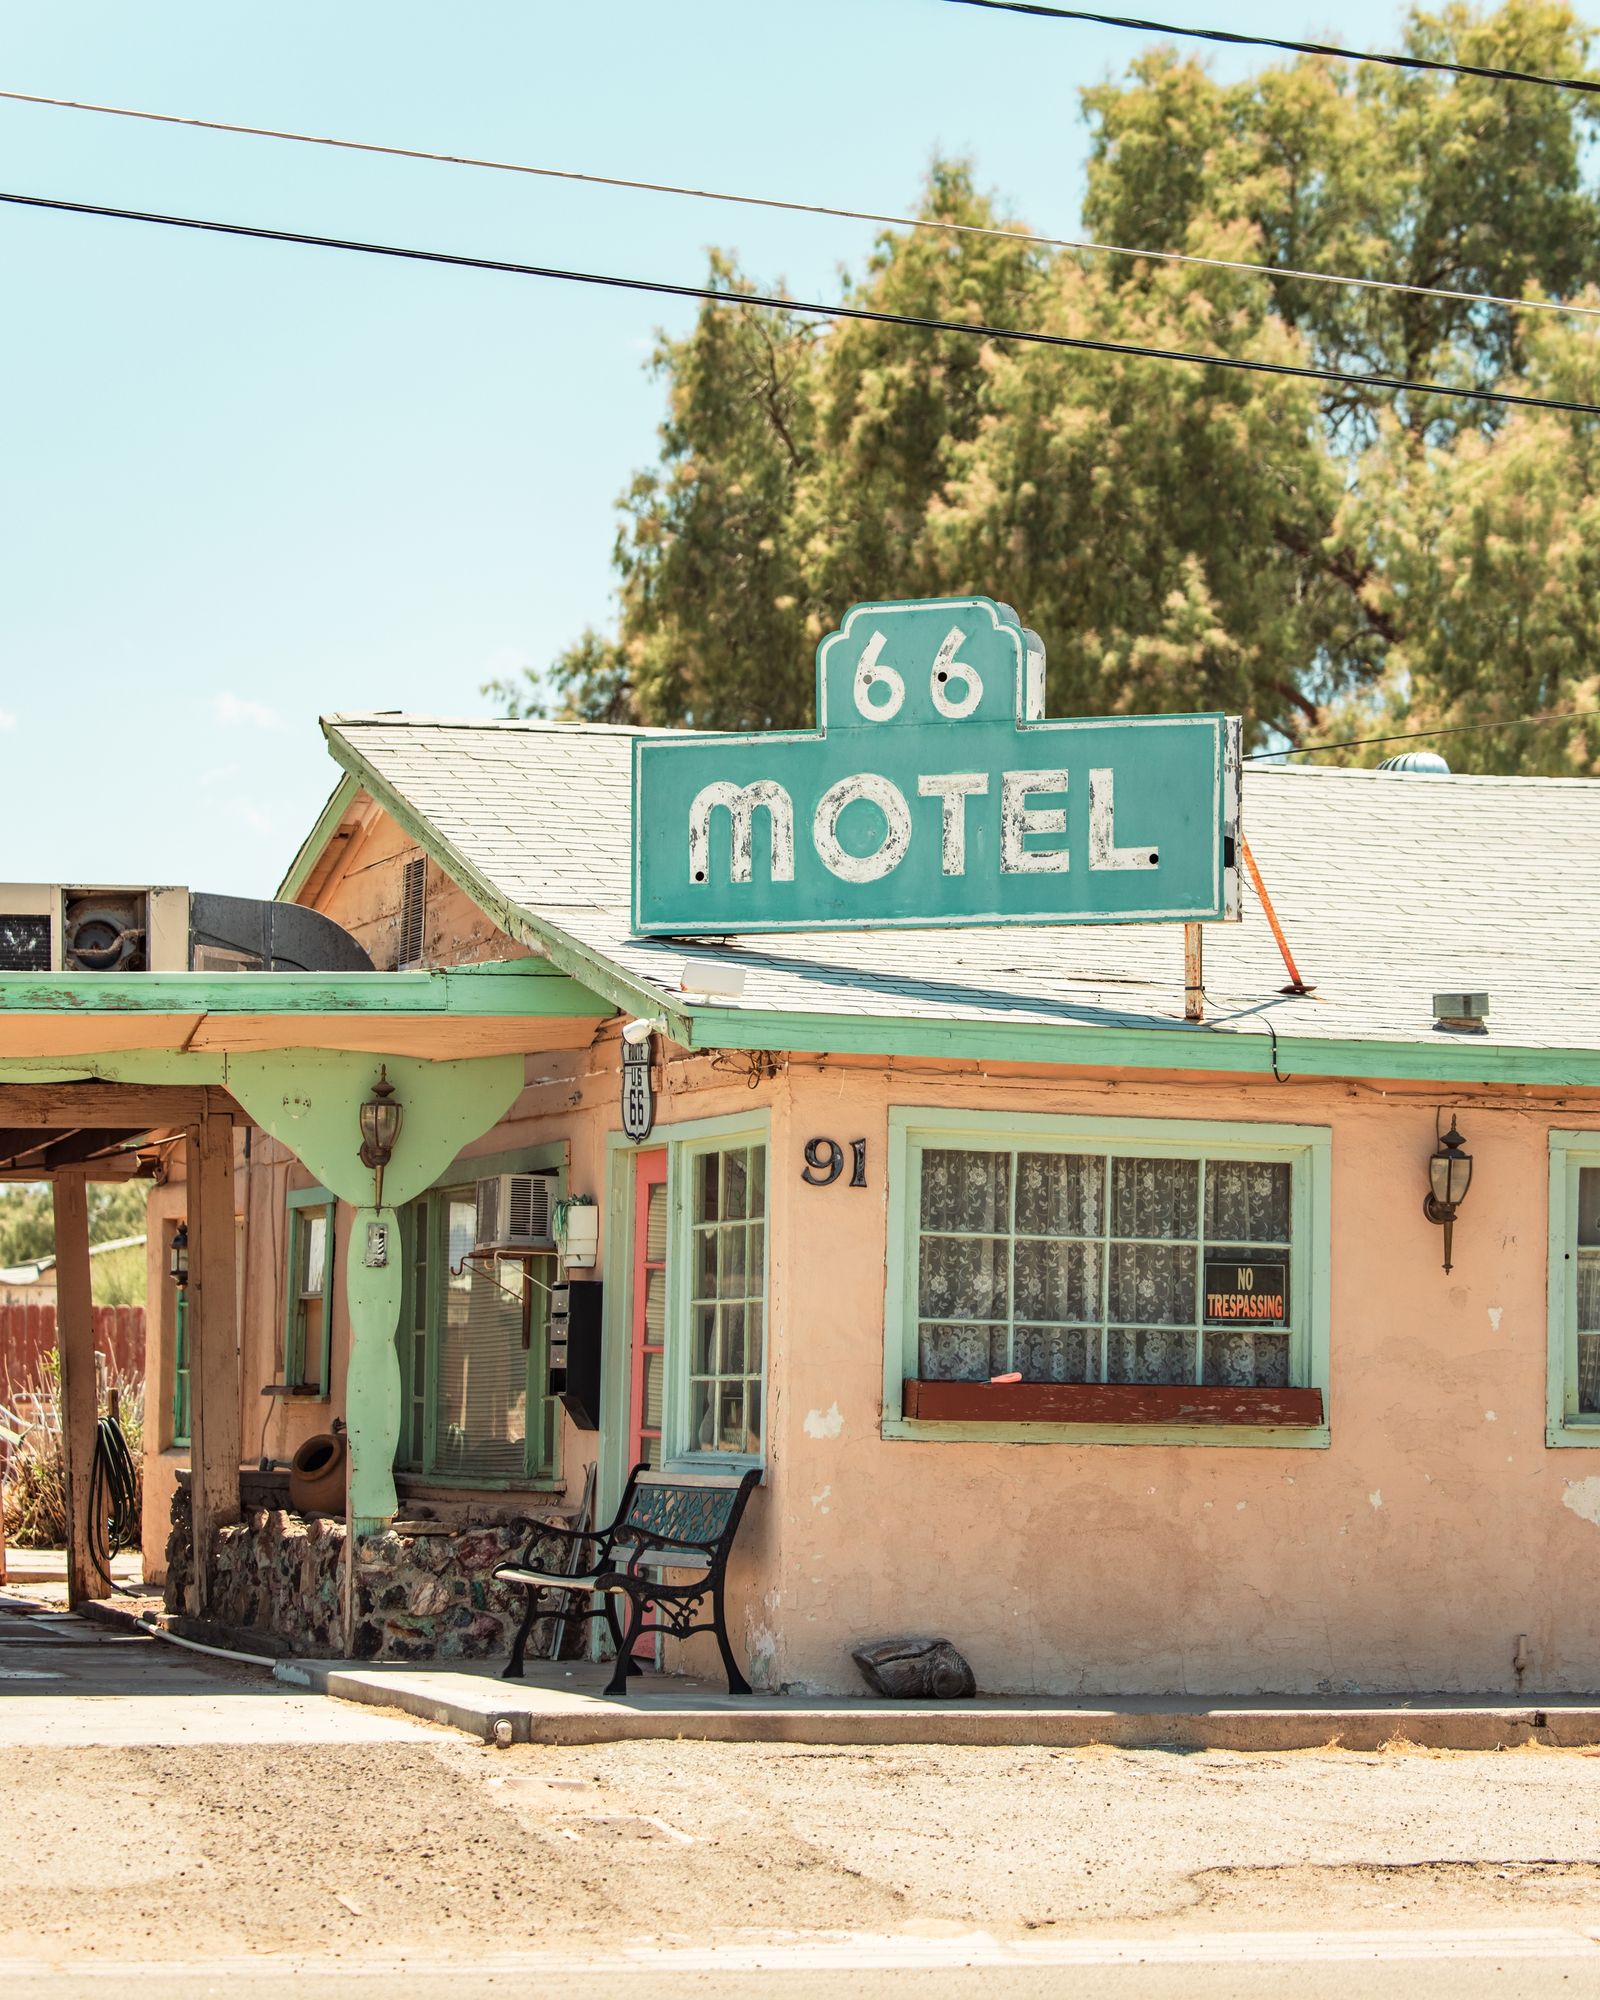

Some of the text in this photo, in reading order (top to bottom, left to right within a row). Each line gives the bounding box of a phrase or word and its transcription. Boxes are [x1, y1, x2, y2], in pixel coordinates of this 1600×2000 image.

[853, 625, 983, 722] 66
[689, 767, 1159, 885] MOTEL
[631, 1067, 642, 1086] US
[629, 1089, 644, 1125] 66
[801, 1137, 867, 1188] 91
[1237, 1267, 1254, 1291] NO
[1207, 1294, 1283, 1318] TRESPASSING
